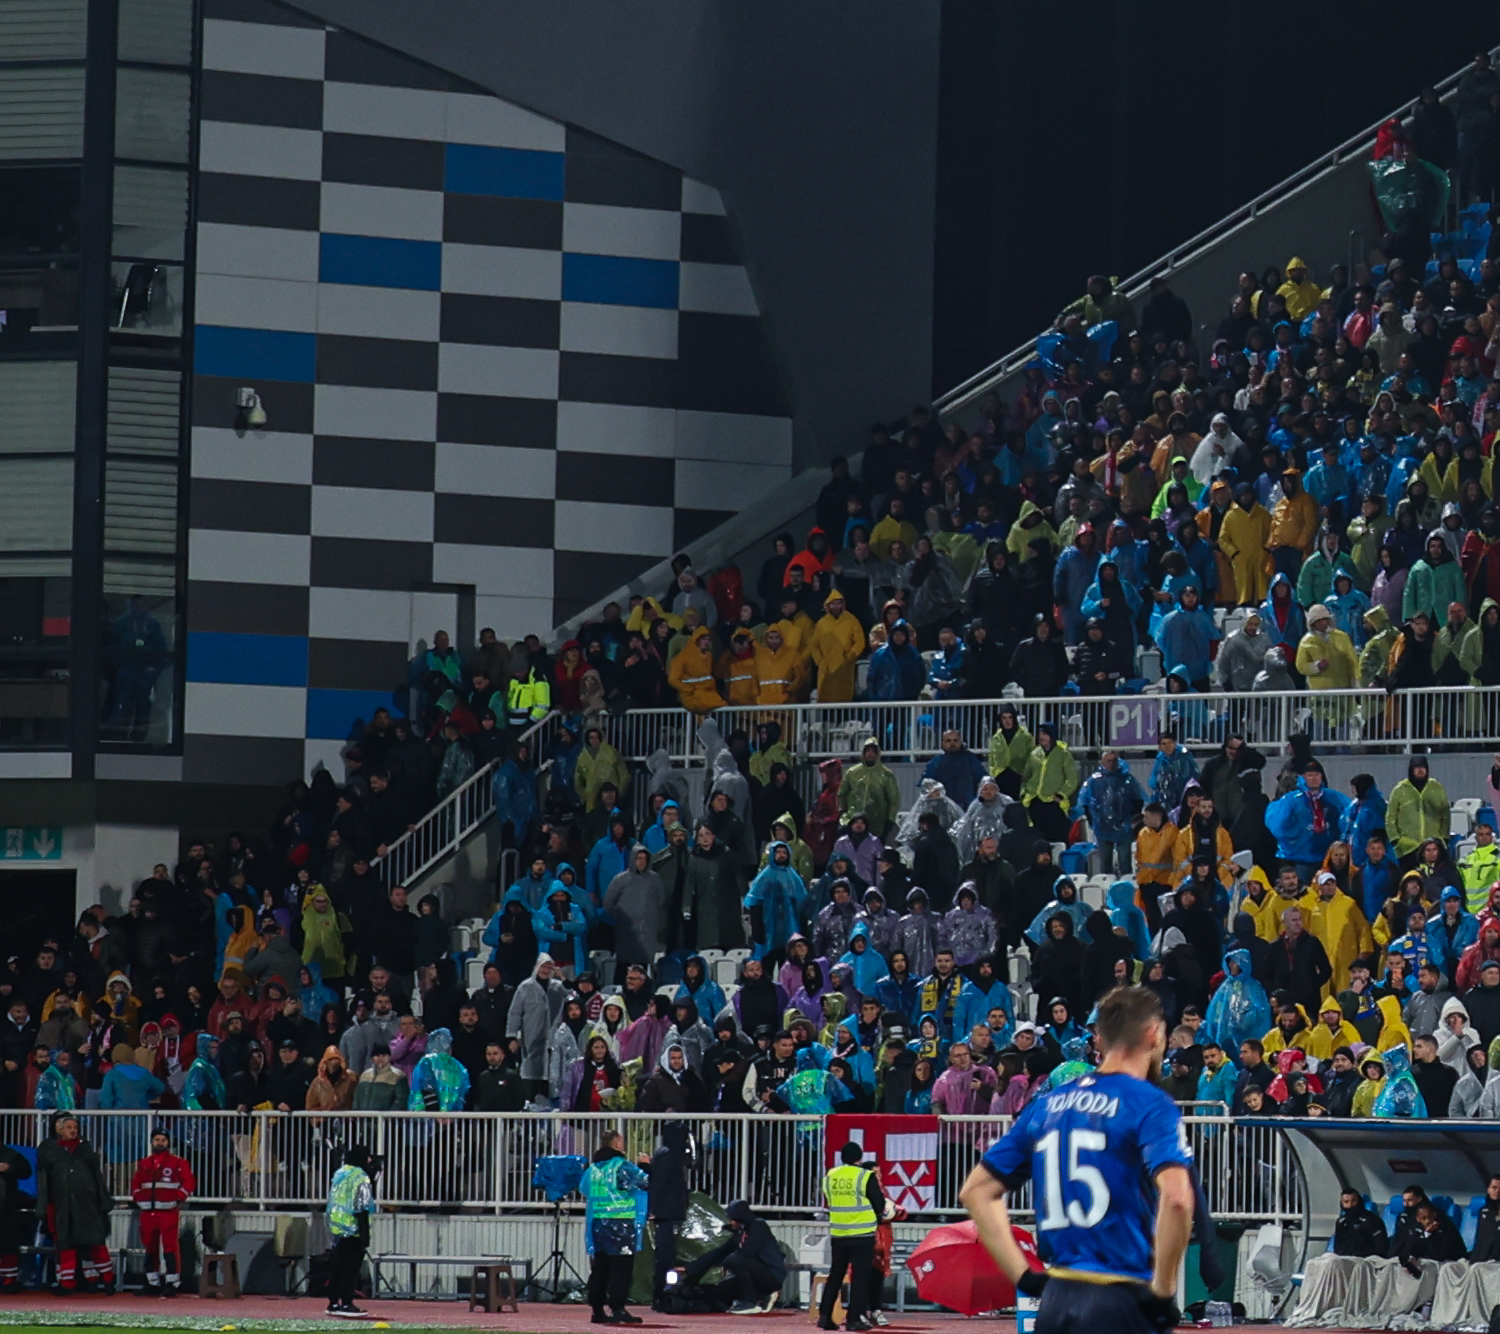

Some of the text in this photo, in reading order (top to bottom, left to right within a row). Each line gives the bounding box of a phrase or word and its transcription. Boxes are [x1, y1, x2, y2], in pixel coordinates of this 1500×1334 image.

[1111, 703, 1143, 740] P1
[832, 1178, 853, 1190] 208
[1035, 1128, 1111, 1231] 15
